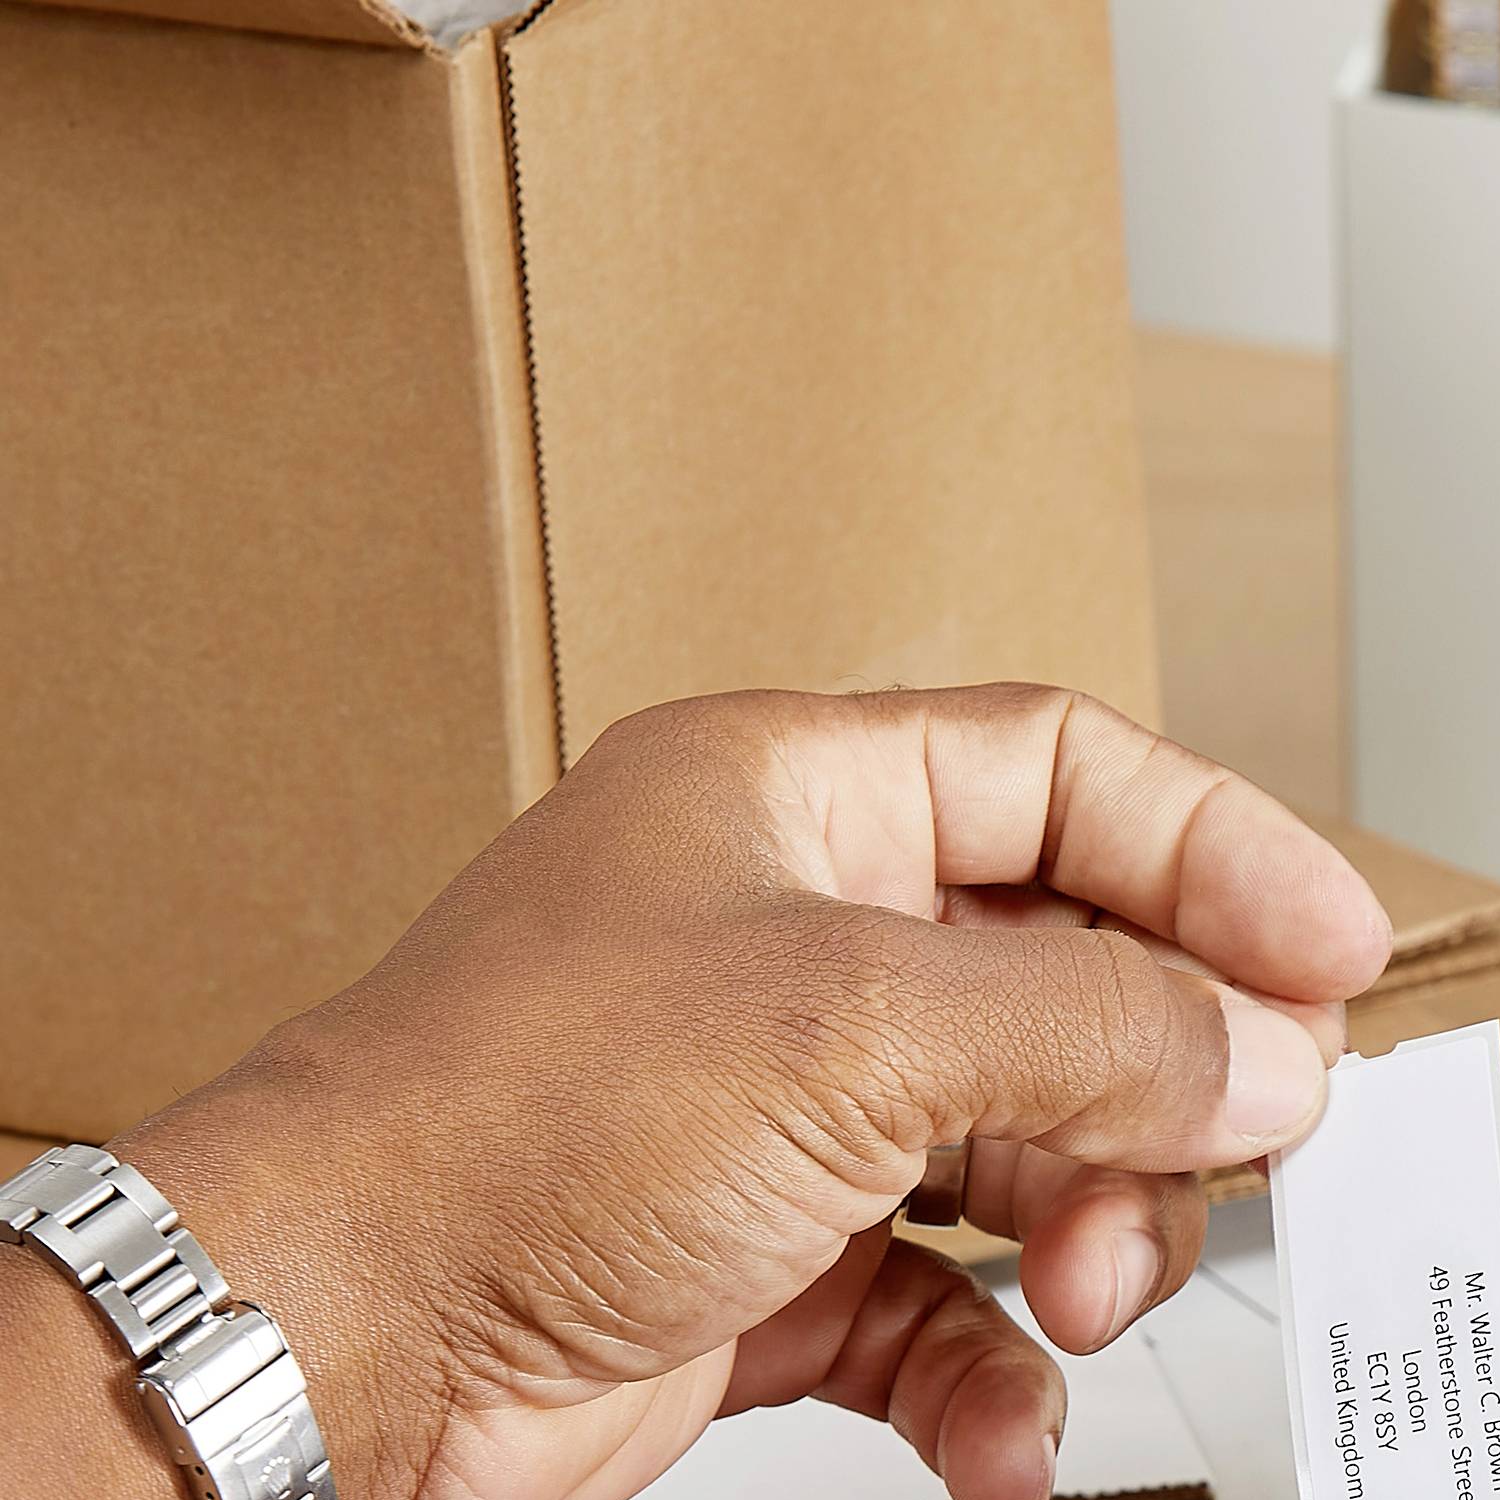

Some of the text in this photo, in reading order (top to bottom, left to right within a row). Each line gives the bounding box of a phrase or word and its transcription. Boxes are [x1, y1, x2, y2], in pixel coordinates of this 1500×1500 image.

[1428, 1266, 1450, 1291] 49
[1464, 1271, 1486, 1308] Mr.
[1431, 1298, 1463, 1439] Featherstone
[1469, 1312, 1494, 1385] Walter
[1328, 1322, 1364, 1500] United Kingdom
[1367, 1351, 1399, 1451] EC1Y 8SY
[1402, 1350, 1428, 1432] London
[1480, 1391, 1500, 1413] C.
